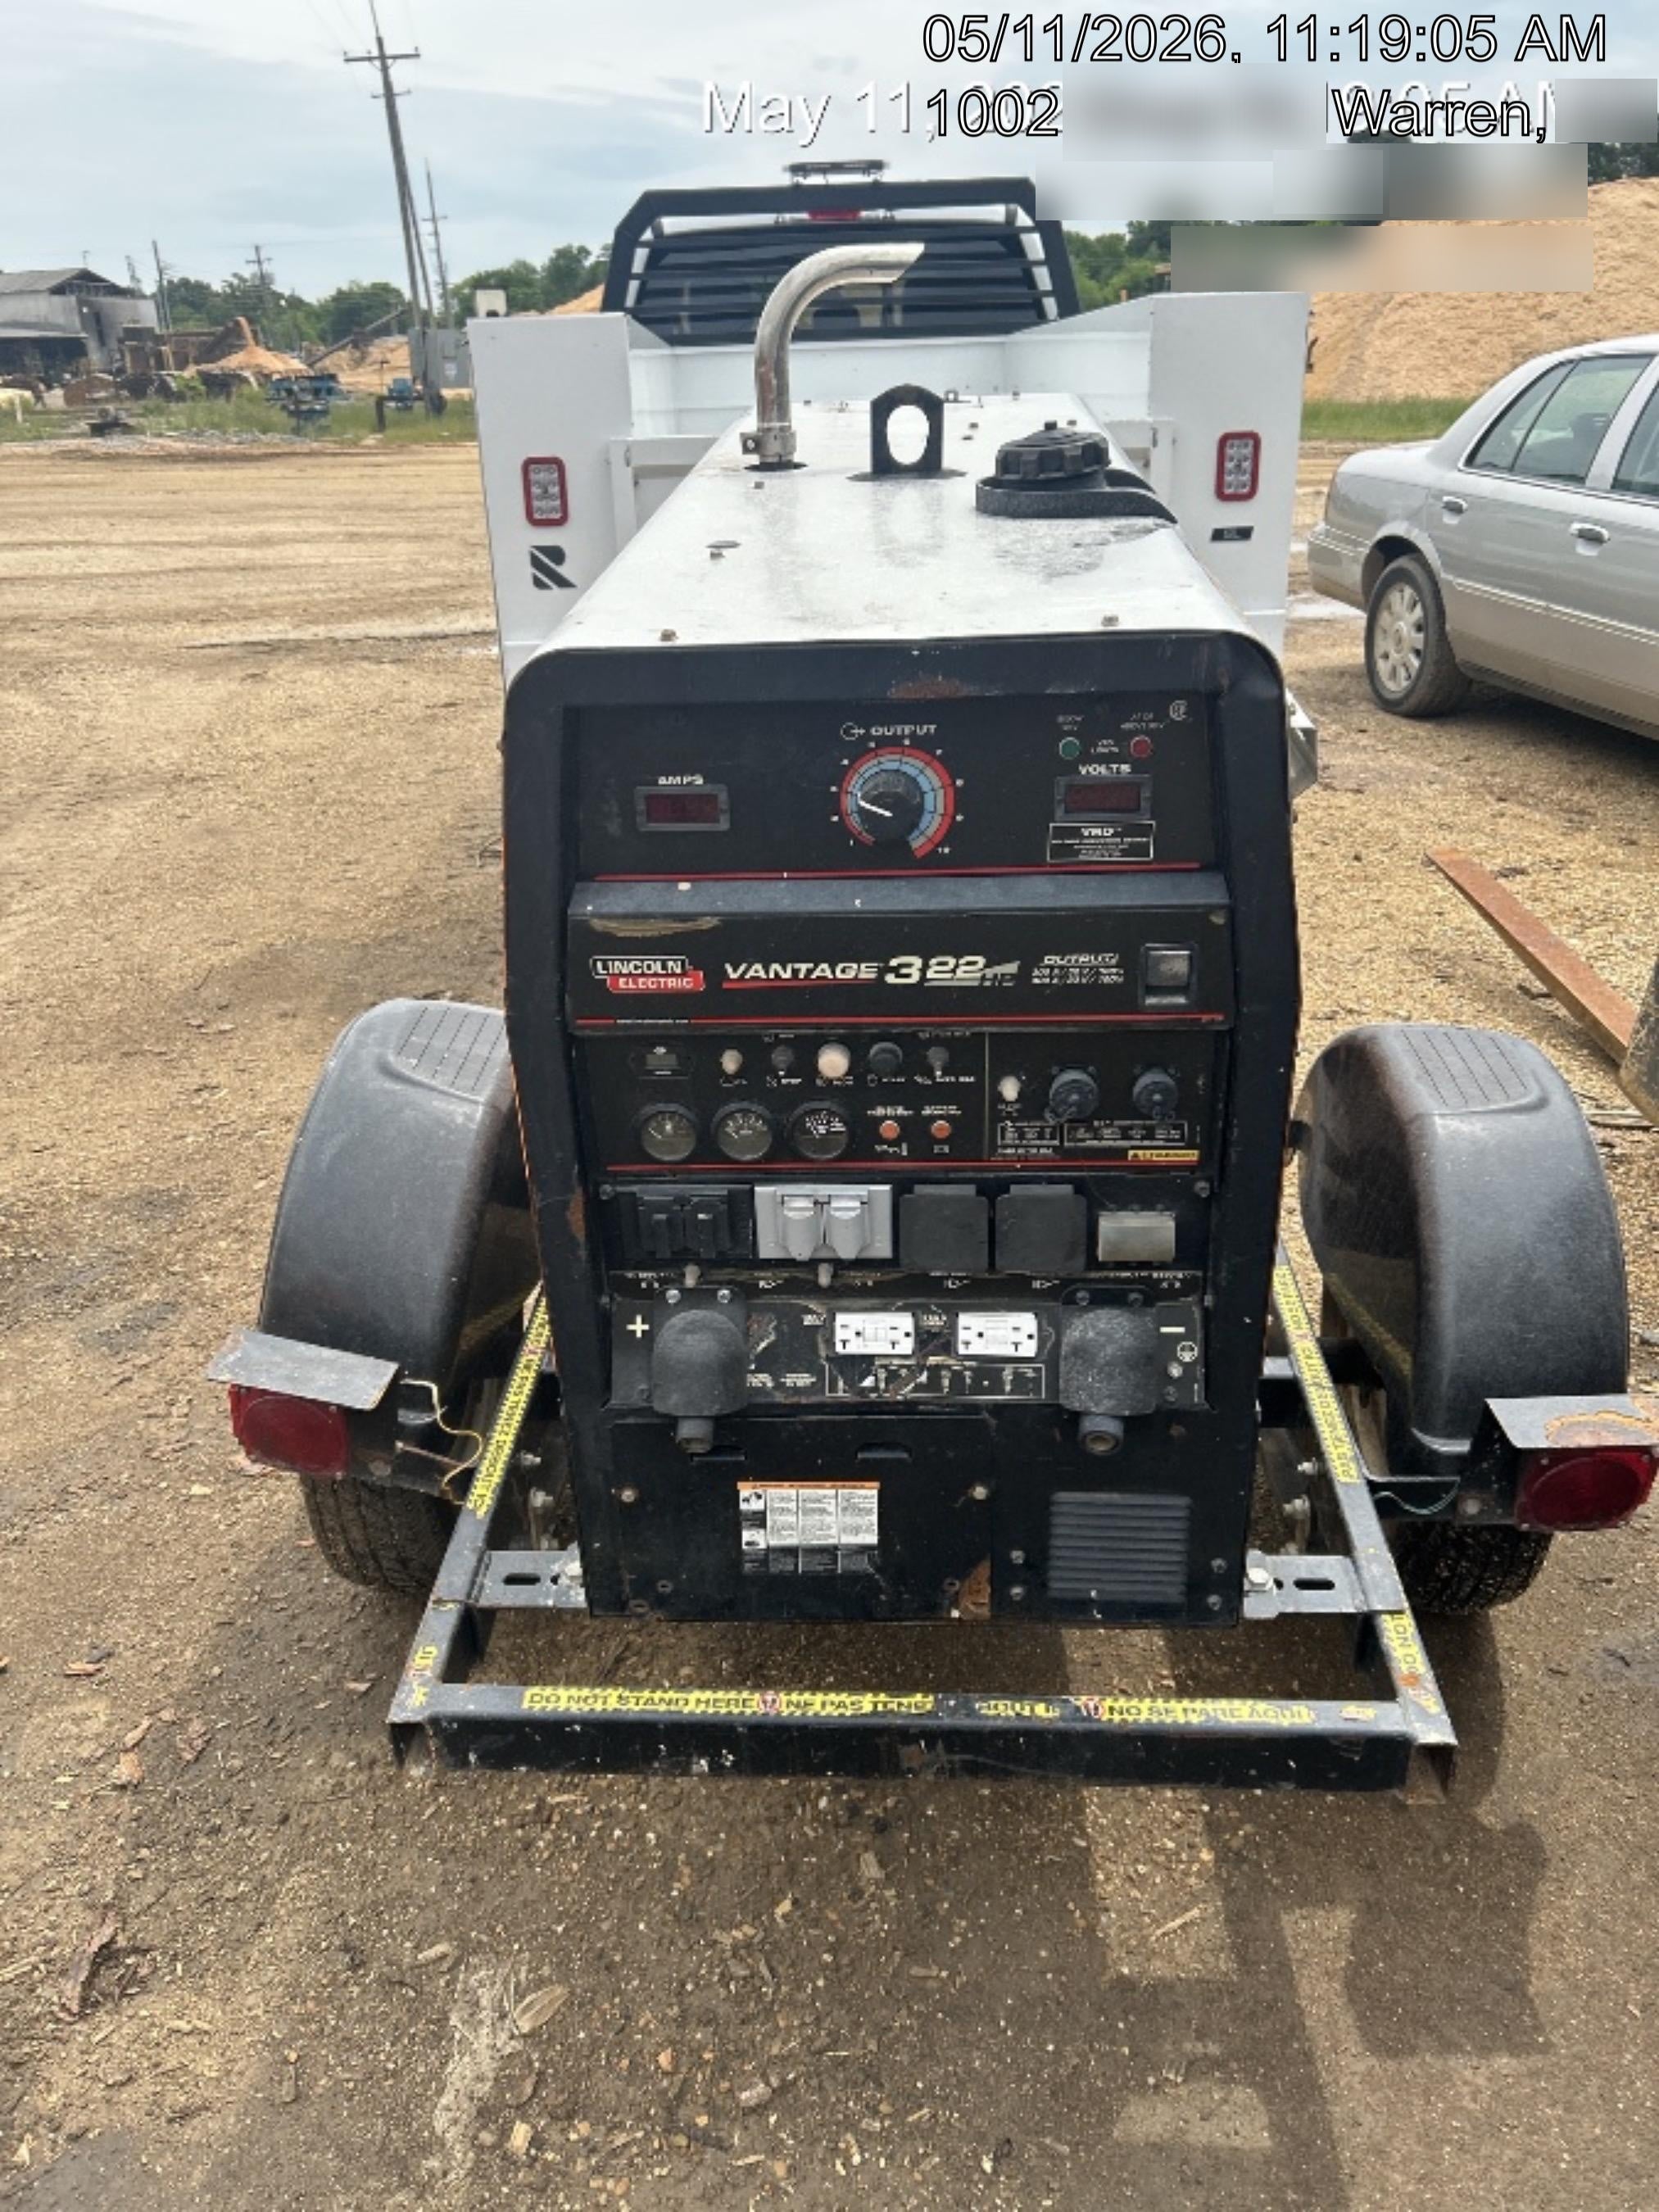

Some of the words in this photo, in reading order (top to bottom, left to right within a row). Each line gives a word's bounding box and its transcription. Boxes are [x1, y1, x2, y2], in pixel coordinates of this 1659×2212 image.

[869, 724, 937, 737] OUTPUT
[1078, 764, 1132, 776] VOLTS
[596, 959, 682, 975] LINCOLN
[723, 962, 880, 980] VANTAGE
[884, 954, 987, 985] 322
[618, 977, 694, 990] ELECTRIC
[527, 1693, 561, 1705] DO
[566, 1693, 612, 1707] NOT
[616, 1693, 689, 1707] STAND
[696, 1697, 756, 1710] HERE
[1108, 1704, 1141, 1717] NO
